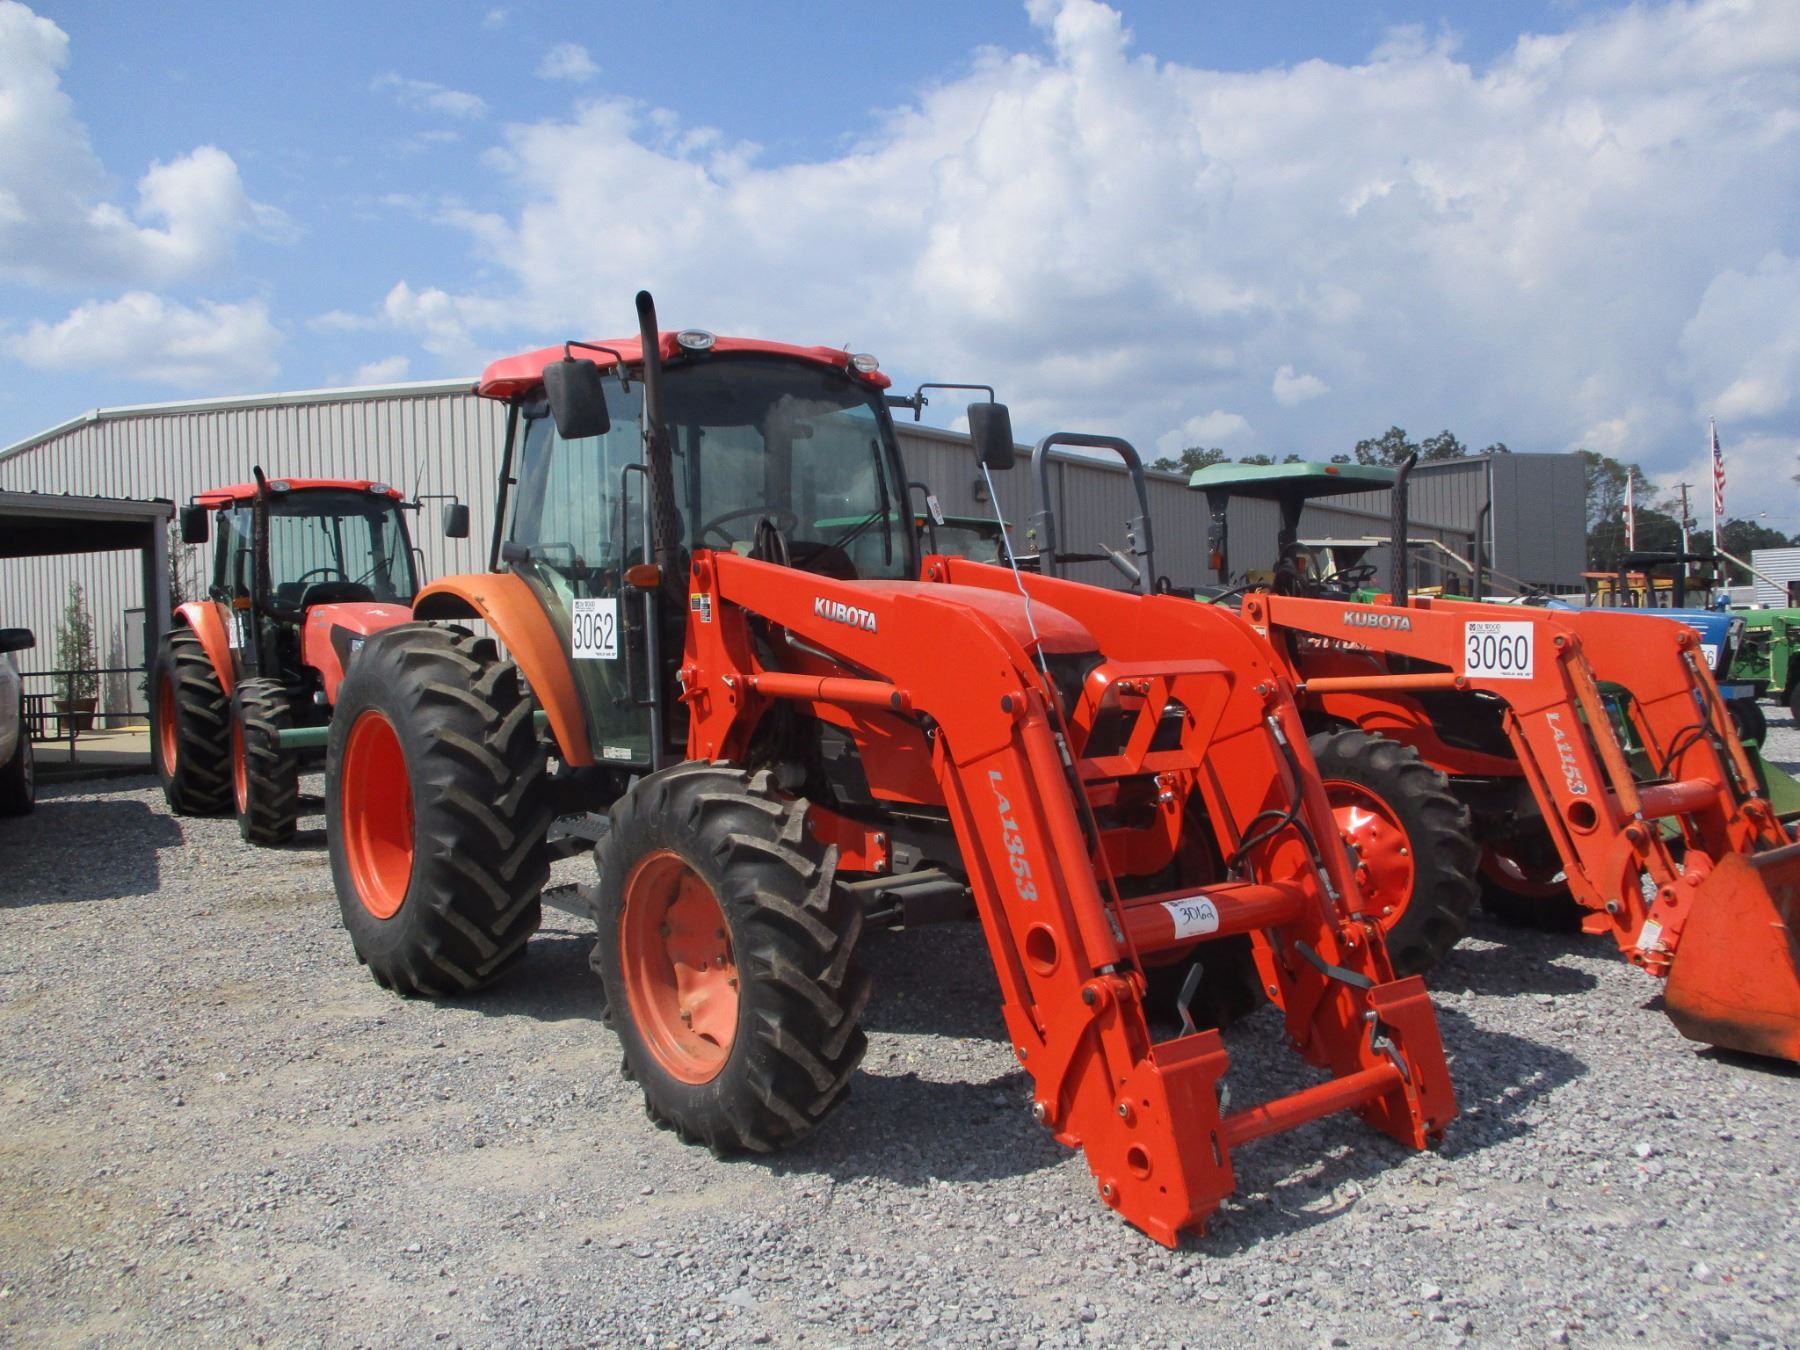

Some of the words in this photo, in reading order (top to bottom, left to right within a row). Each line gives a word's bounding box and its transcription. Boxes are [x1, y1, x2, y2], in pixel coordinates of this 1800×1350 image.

[574, 613, 614, 649] 3062
[814, 596, 878, 633] KUBOTA
[1343, 611, 1411, 632] KUBOTA
[1467, 635, 1528, 670] 3060
[1546, 712, 1588, 795] LA1153
[988, 770, 1038, 902] LA1353
[1179, 903, 1215, 926] 3062
